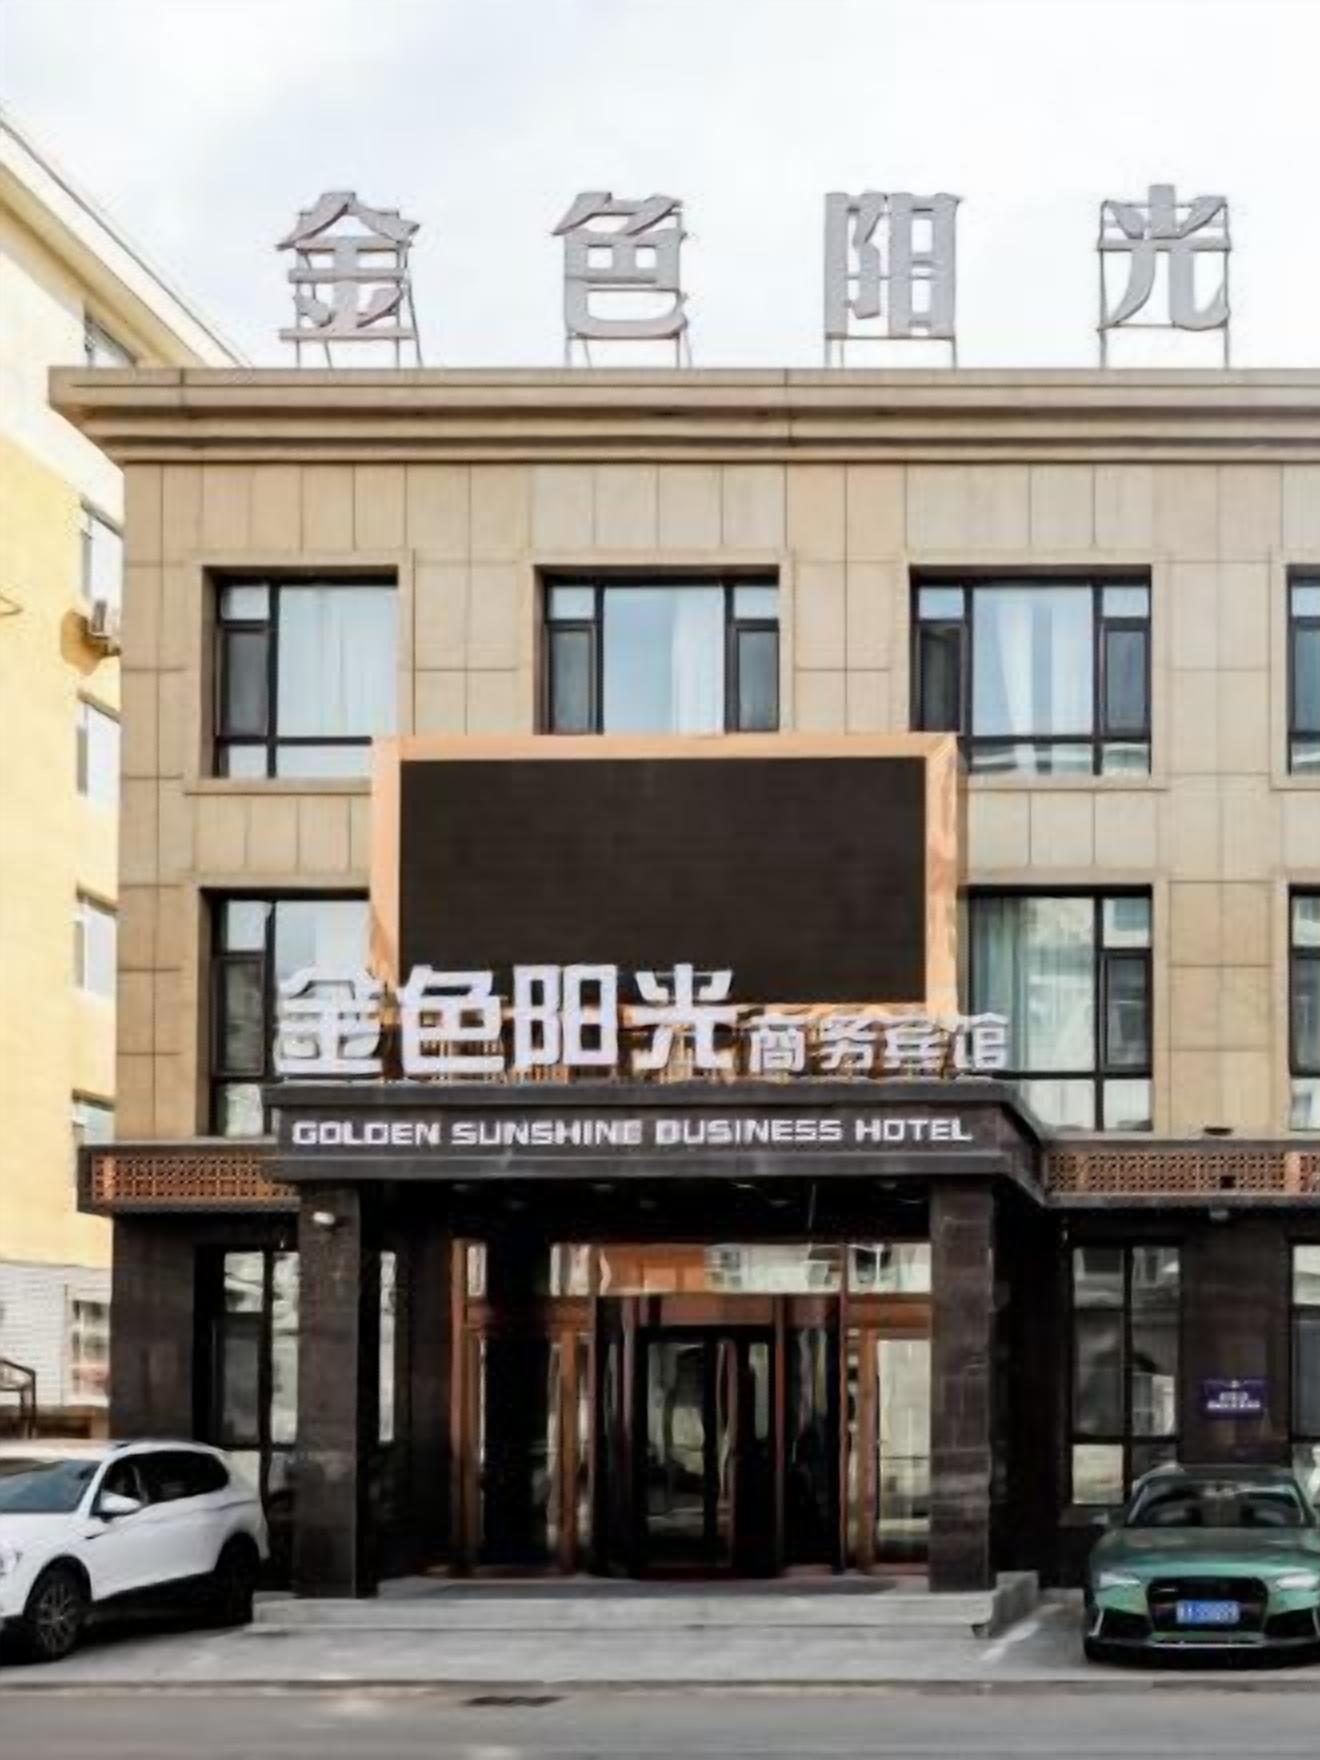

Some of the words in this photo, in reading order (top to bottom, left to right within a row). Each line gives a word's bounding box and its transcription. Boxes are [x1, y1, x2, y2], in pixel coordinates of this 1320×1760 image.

[293, 1120, 441, 1145] GOLDEN
[655, 1119, 843, 1145] BUSINESS
[855, 1119, 973, 1142] HOTEL
